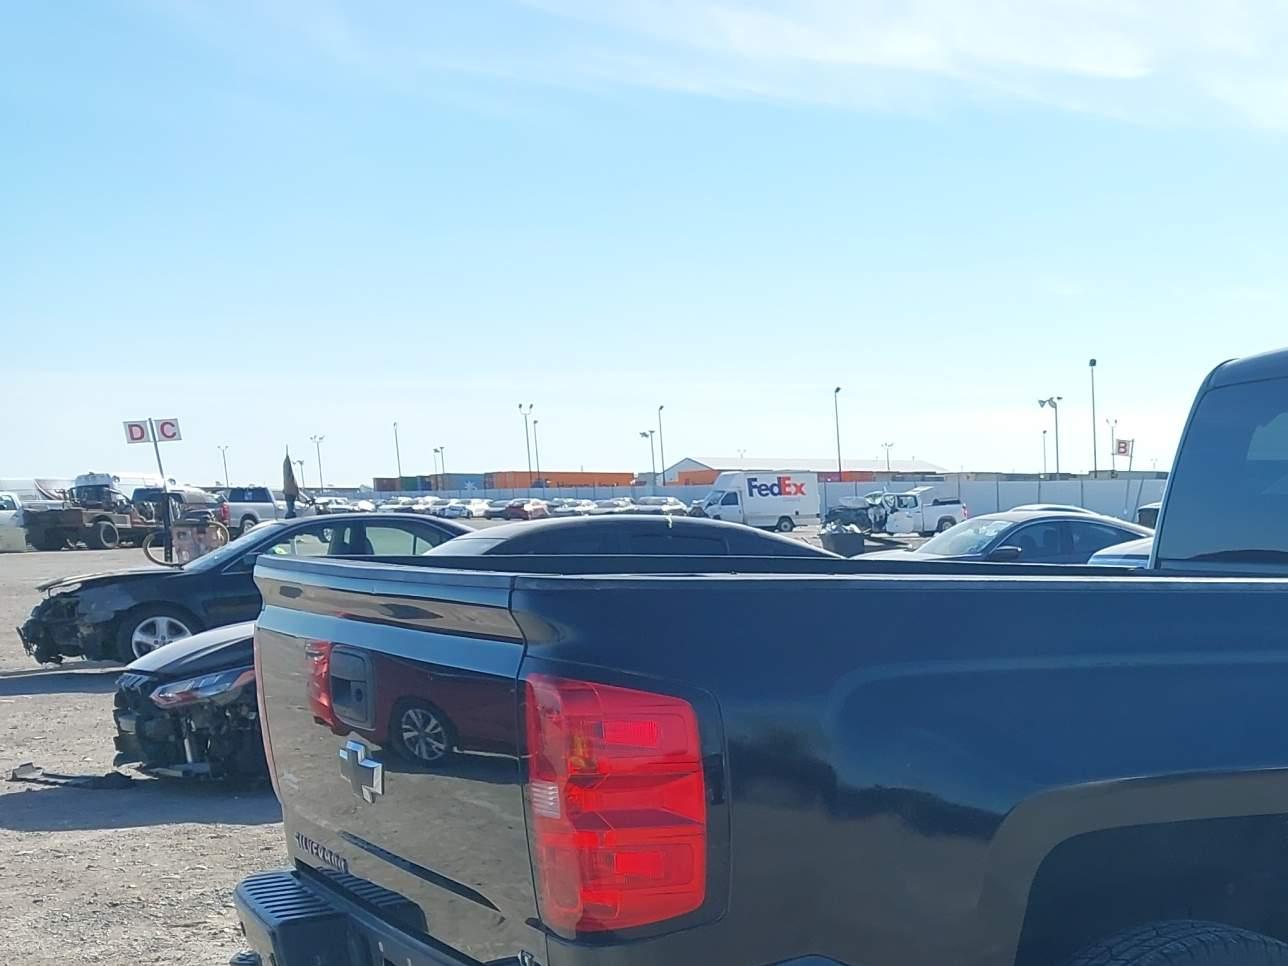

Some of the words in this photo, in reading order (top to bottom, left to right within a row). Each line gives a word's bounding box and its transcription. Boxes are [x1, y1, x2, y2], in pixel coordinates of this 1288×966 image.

[127, 423, 145, 441] D
[160, 421, 177, 439] C
[1117, 441, 1128, 454] B
[746, 475, 807, 497] FedEx
